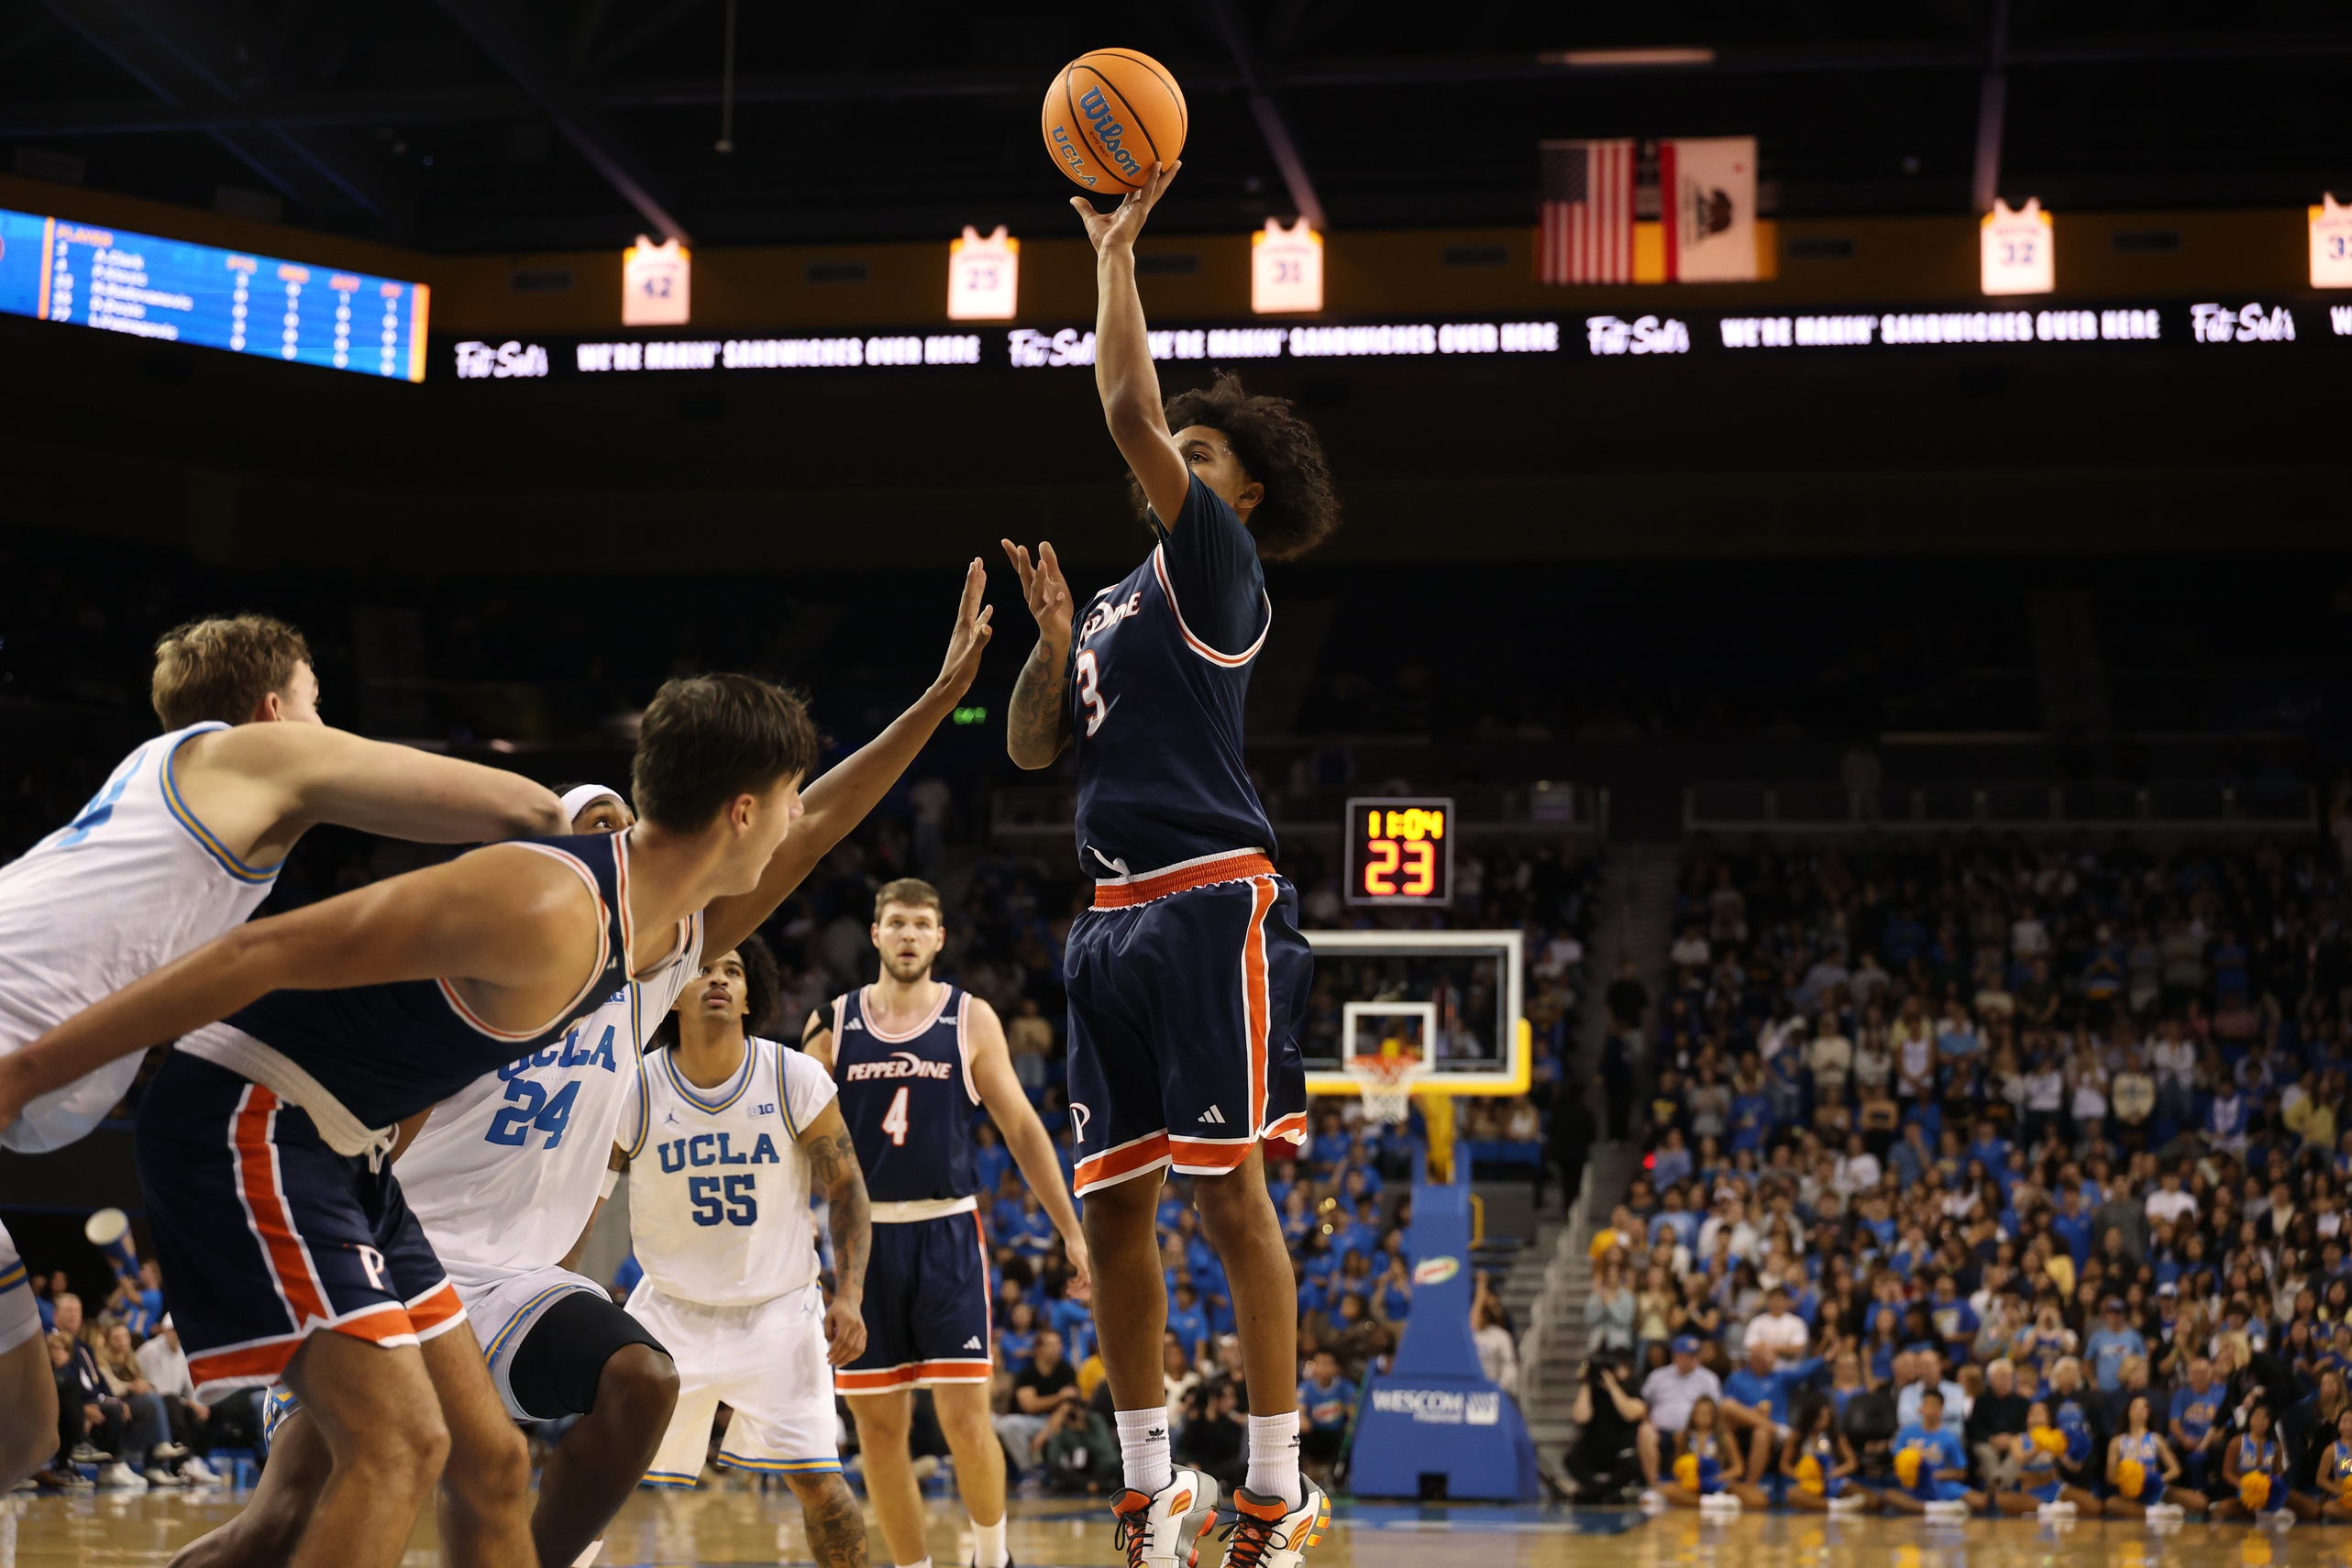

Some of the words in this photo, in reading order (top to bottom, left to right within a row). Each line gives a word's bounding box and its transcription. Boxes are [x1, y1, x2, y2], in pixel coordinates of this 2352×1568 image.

[1052, 125, 1099, 186] UCLA
[1079, 84, 1142, 178] Wilson
[1076, 649, 1107, 739] 3
[1368, 809, 1443, 840] 11:04
[1364, 840, 1435, 895] 23
[846, 1052, 952, 1081] PEPPERDINE
[485, 1077, 581, 1150] 24
[880, 1087, 909, 1146] 4
[1069, 1102, 1091, 1144] P
[657, 1132, 779, 1174] UCLA
[688, 1174, 757, 1226] 55
